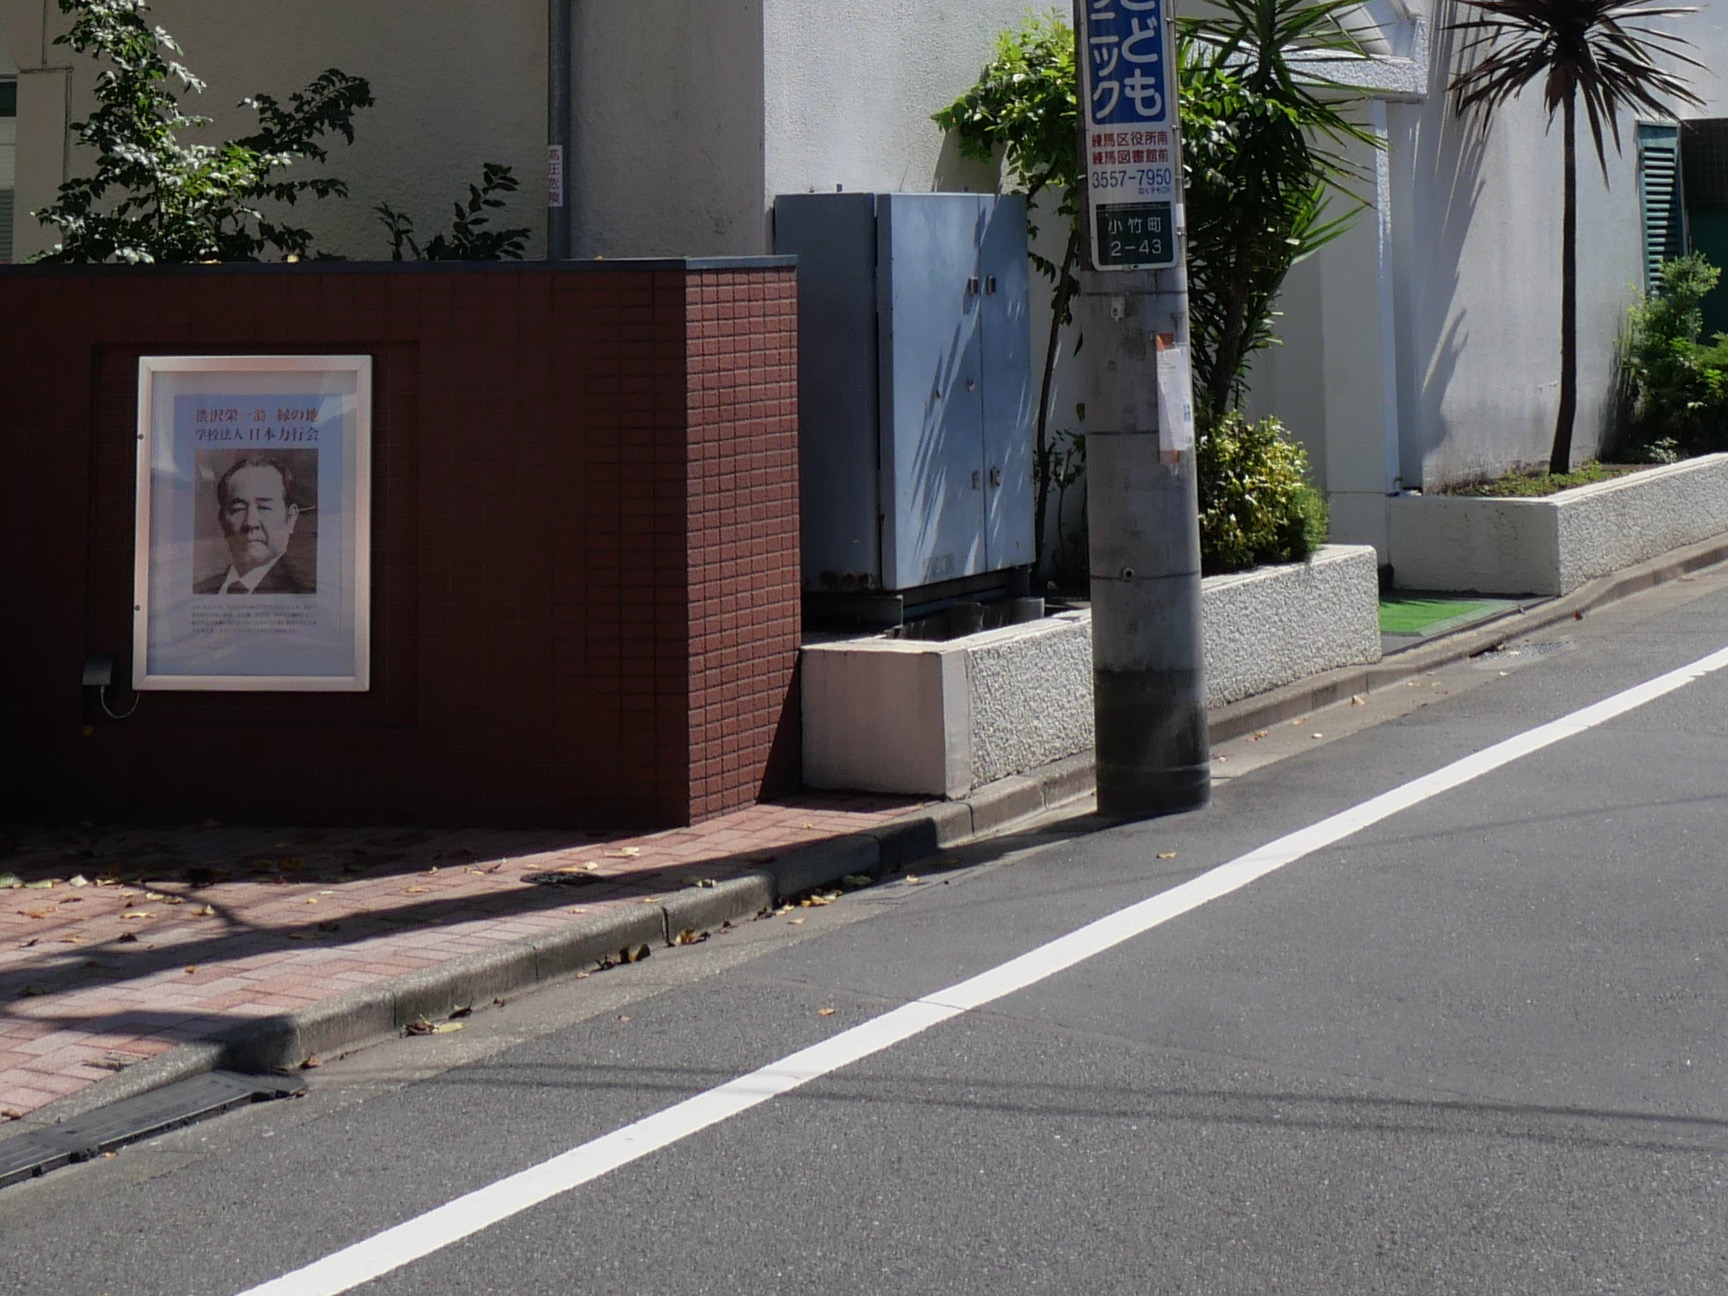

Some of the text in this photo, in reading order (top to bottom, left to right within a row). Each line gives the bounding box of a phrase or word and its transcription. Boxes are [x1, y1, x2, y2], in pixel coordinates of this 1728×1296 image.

[1092, 130, 1169, 148] 練馬区役所南
[1092, 148, 1169, 165] 練馬図書館前
[547, 148, 560, 204] 高圧危険
[1092, 168, 1172, 189] 3557-7950
[1108, 216, 1162, 235] 小竹町
[1111, 239, 1163, 257] 2-43
[195, 426, 319, 442] 学校法人 日本力行会
